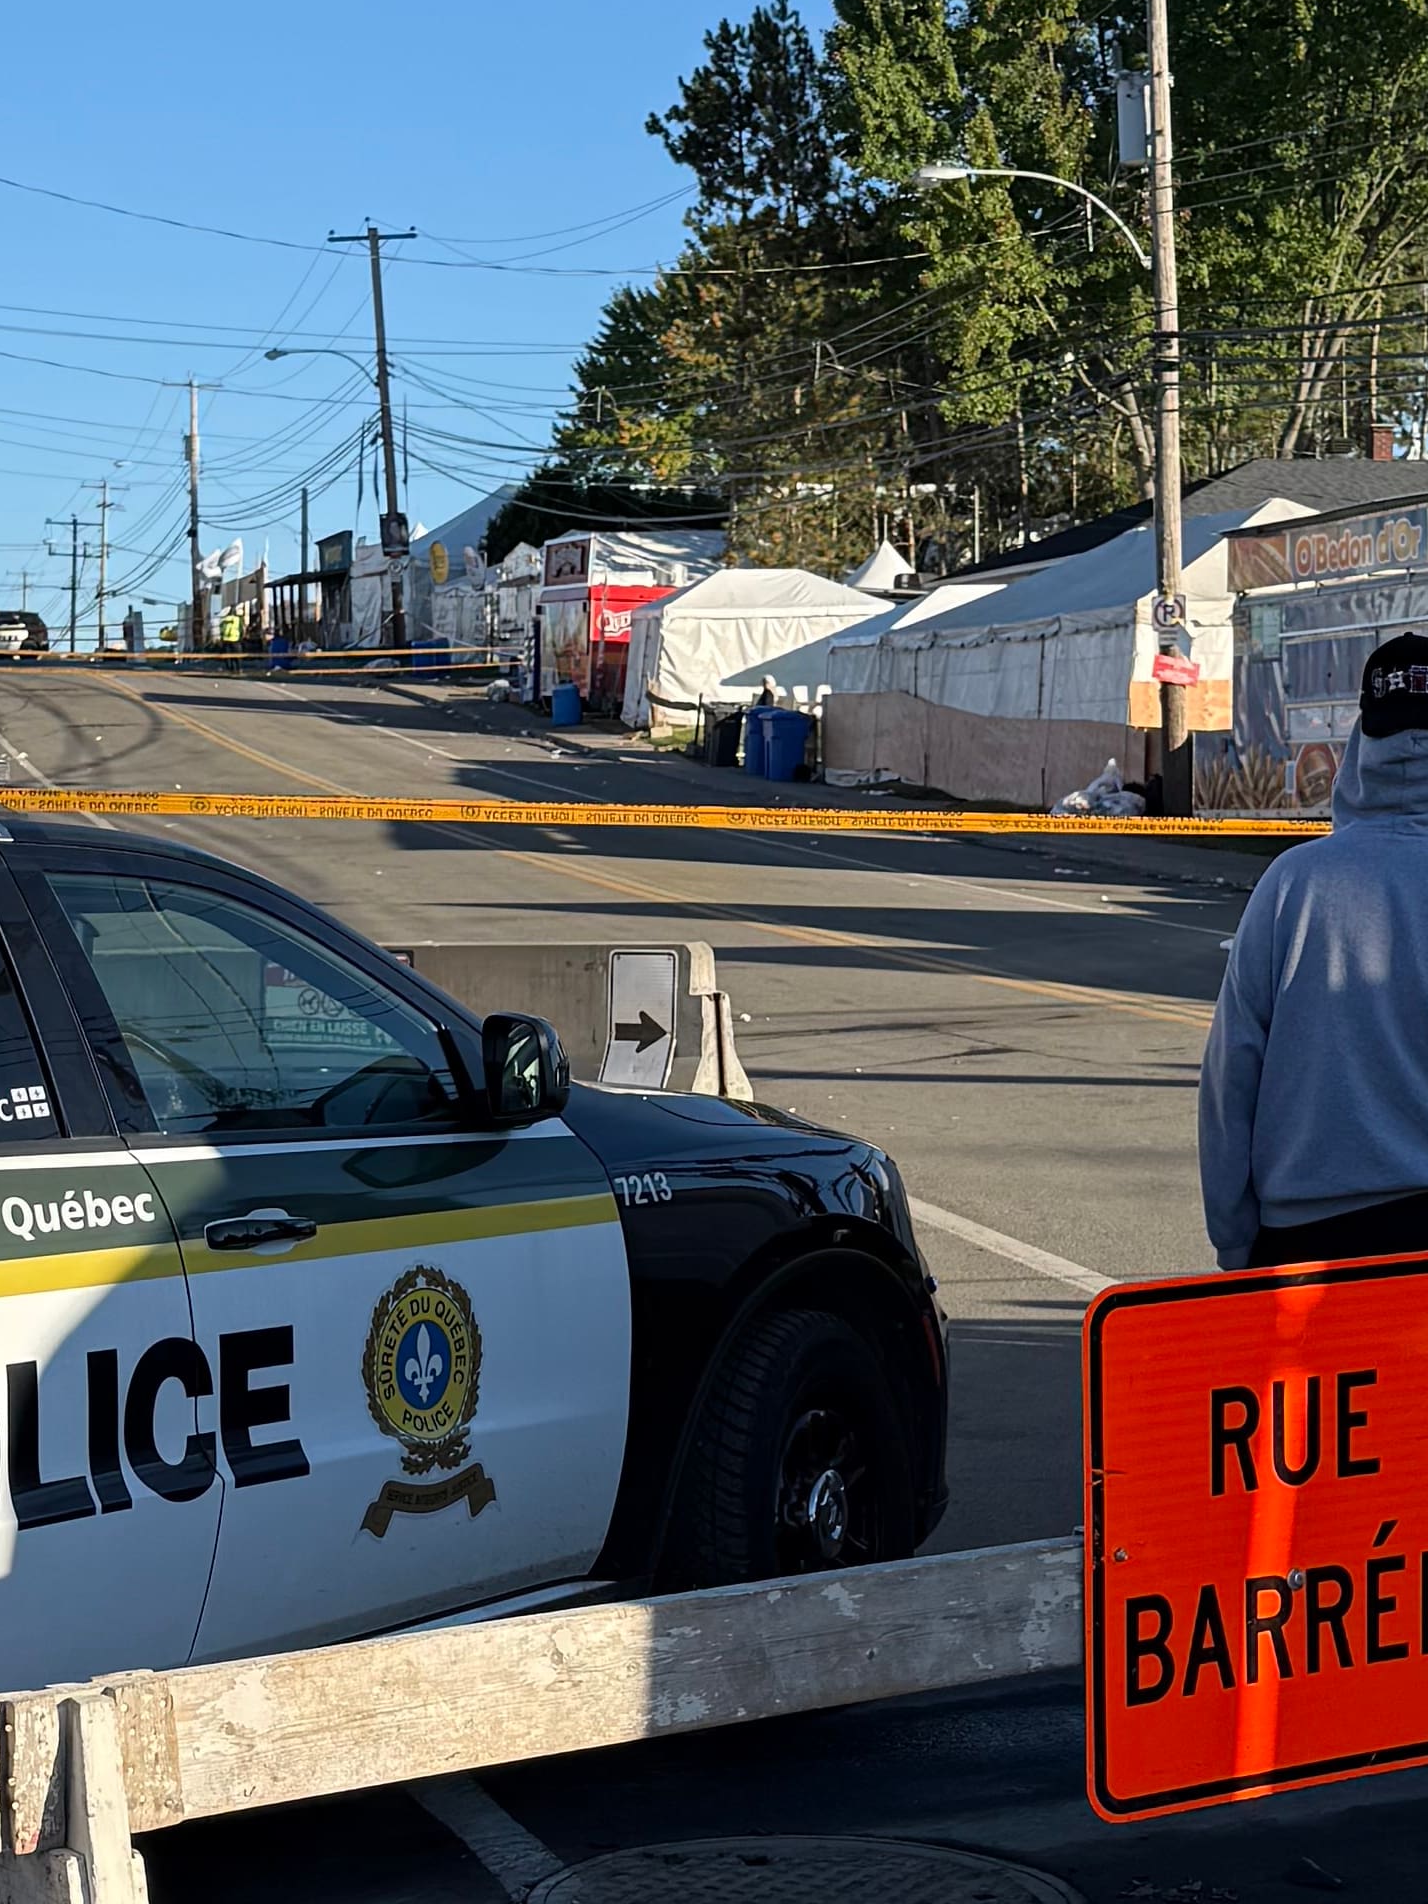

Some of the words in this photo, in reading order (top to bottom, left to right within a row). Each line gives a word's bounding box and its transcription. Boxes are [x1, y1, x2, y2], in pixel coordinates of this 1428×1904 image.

[1294, 525, 1372, 576] O'Bedon
[1376, 518, 1422, 563] d'Or
[1, 1190, 155, 1242] Québec
[614, 1172, 672, 1206] 7213
[379, 1307, 409, 1401] SÛRETÉ
[409, 1295, 430, 1316] DU
[434, 1299, 466, 1385] QUÉBEC
[401, 1400, 455, 1433] POLICE
[1210, 1368, 1381, 1497] RUE
